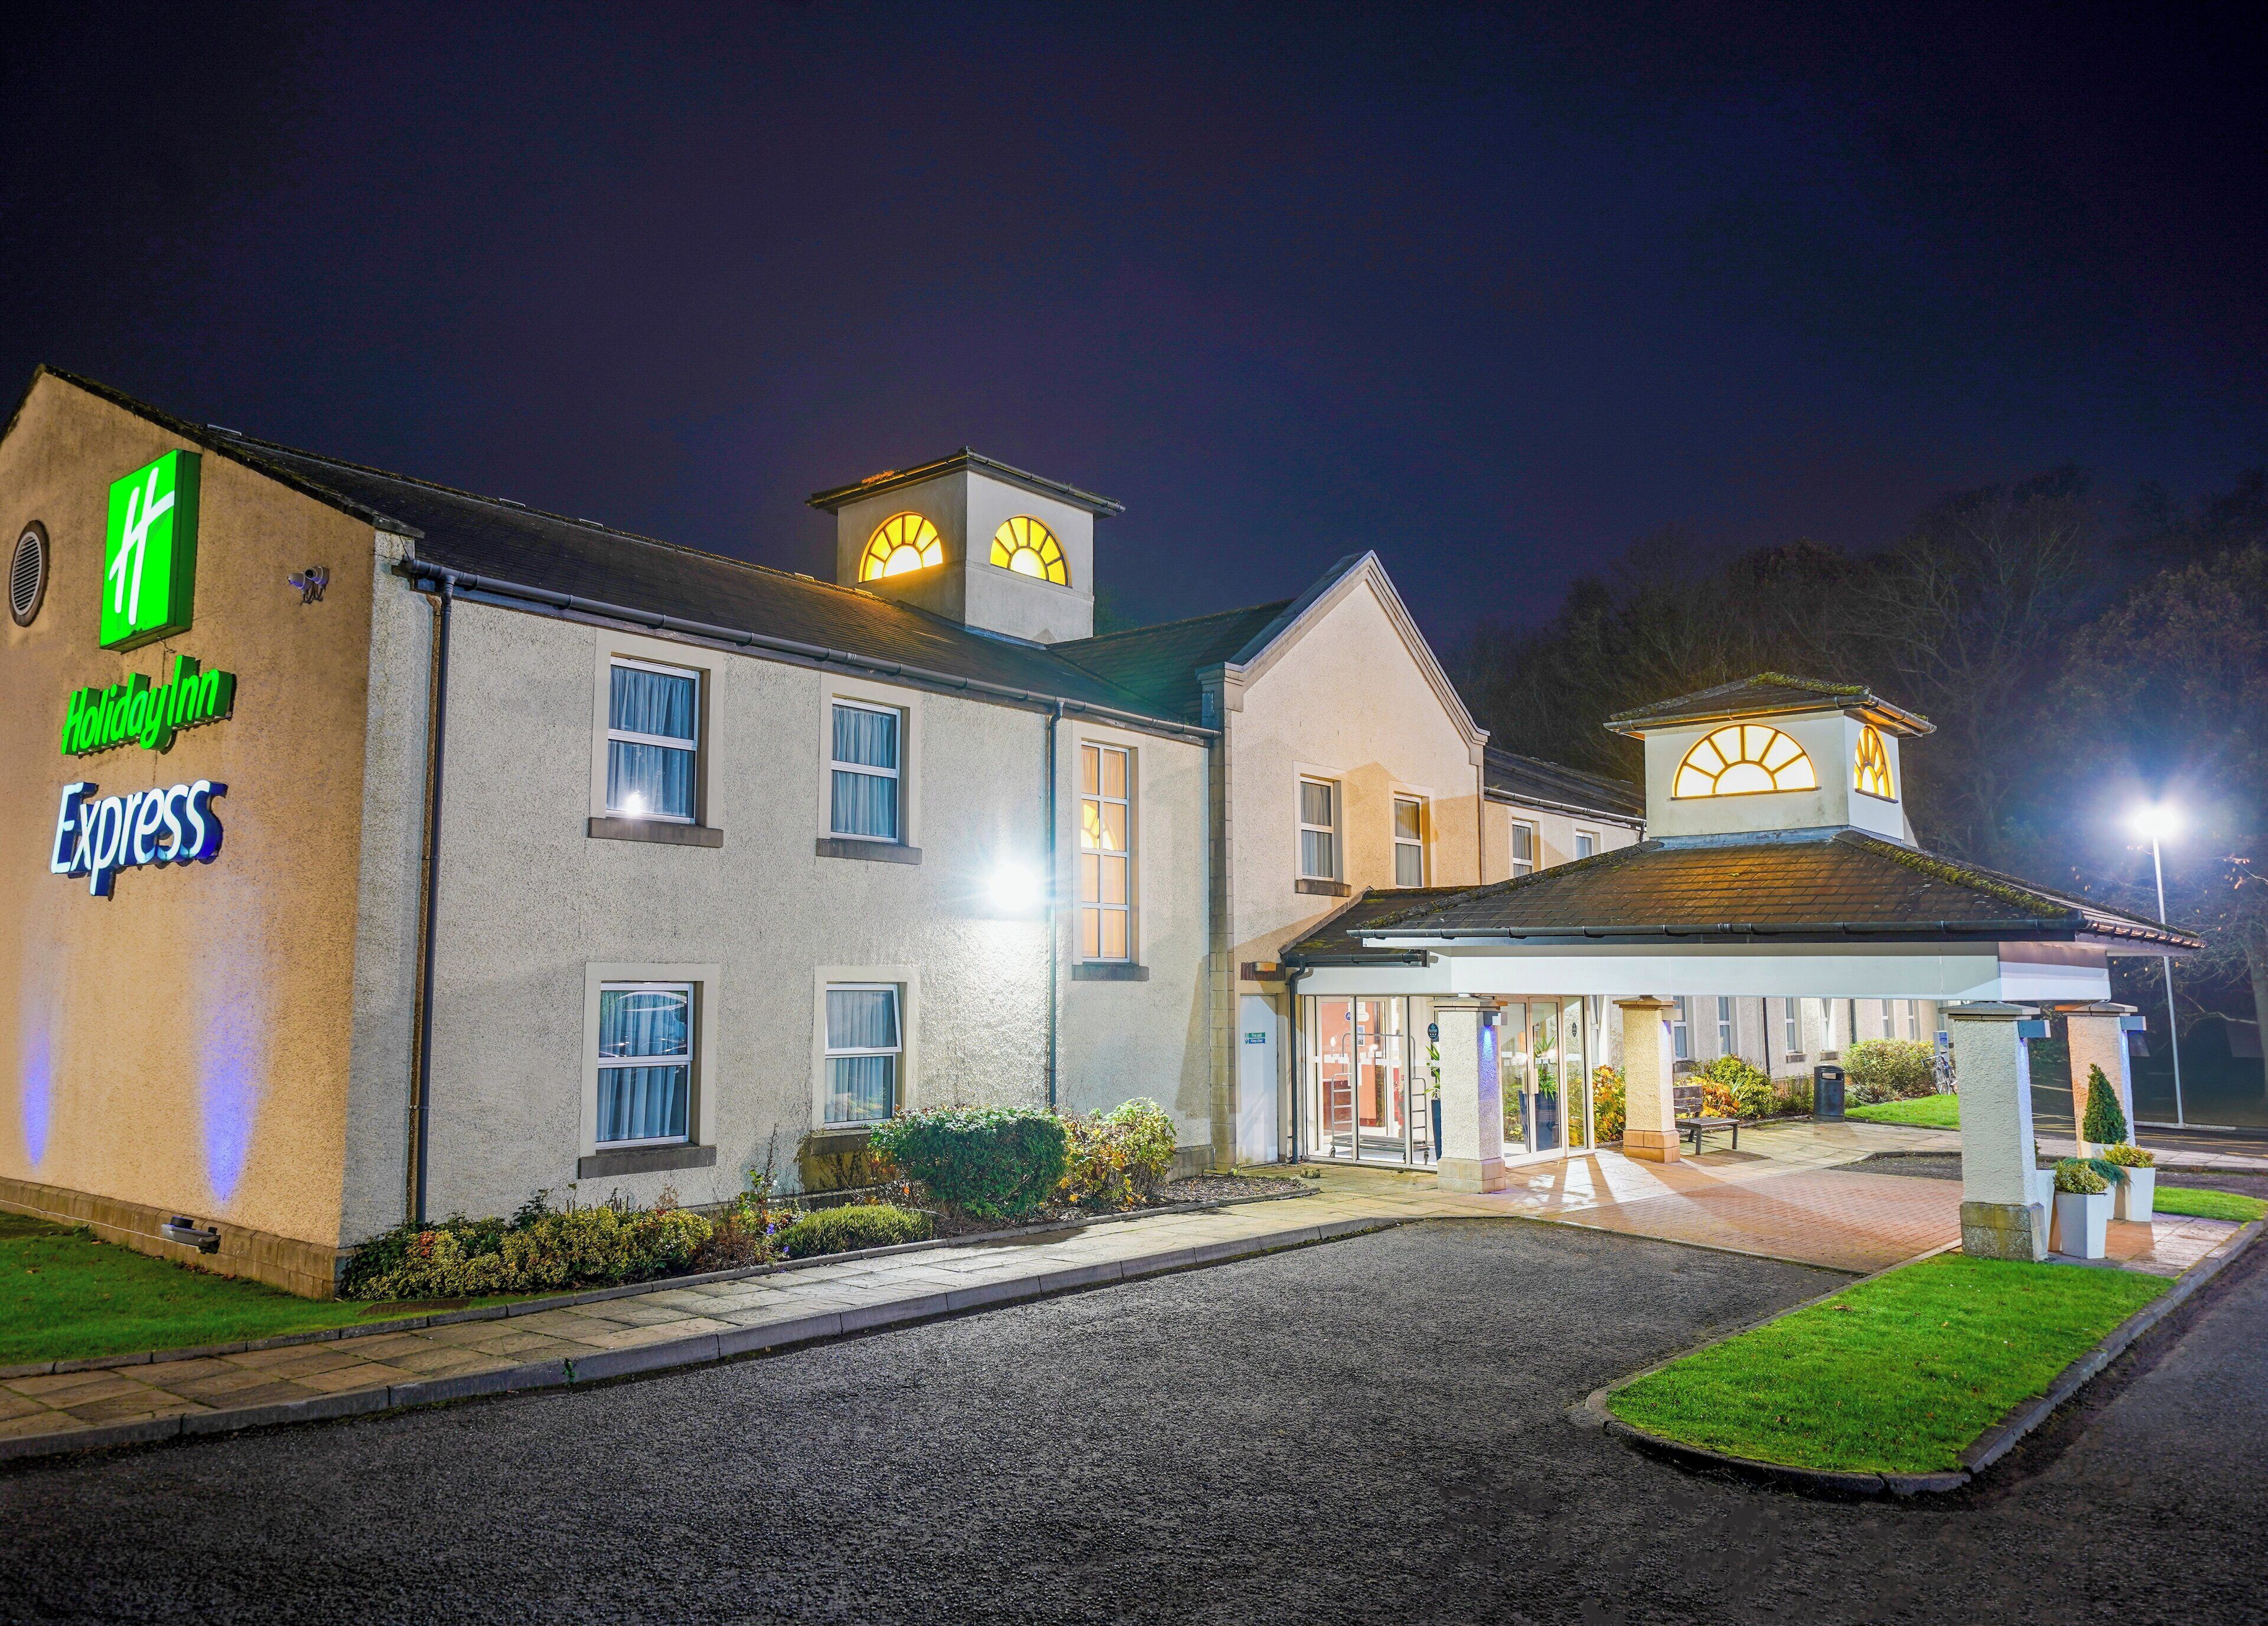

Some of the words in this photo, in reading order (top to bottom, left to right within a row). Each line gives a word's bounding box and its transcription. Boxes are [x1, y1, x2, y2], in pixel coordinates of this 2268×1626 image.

[61, 672, 170, 755] Holiday
[167, 655, 220, 726] Inn
[51, 780, 211, 896] Express
